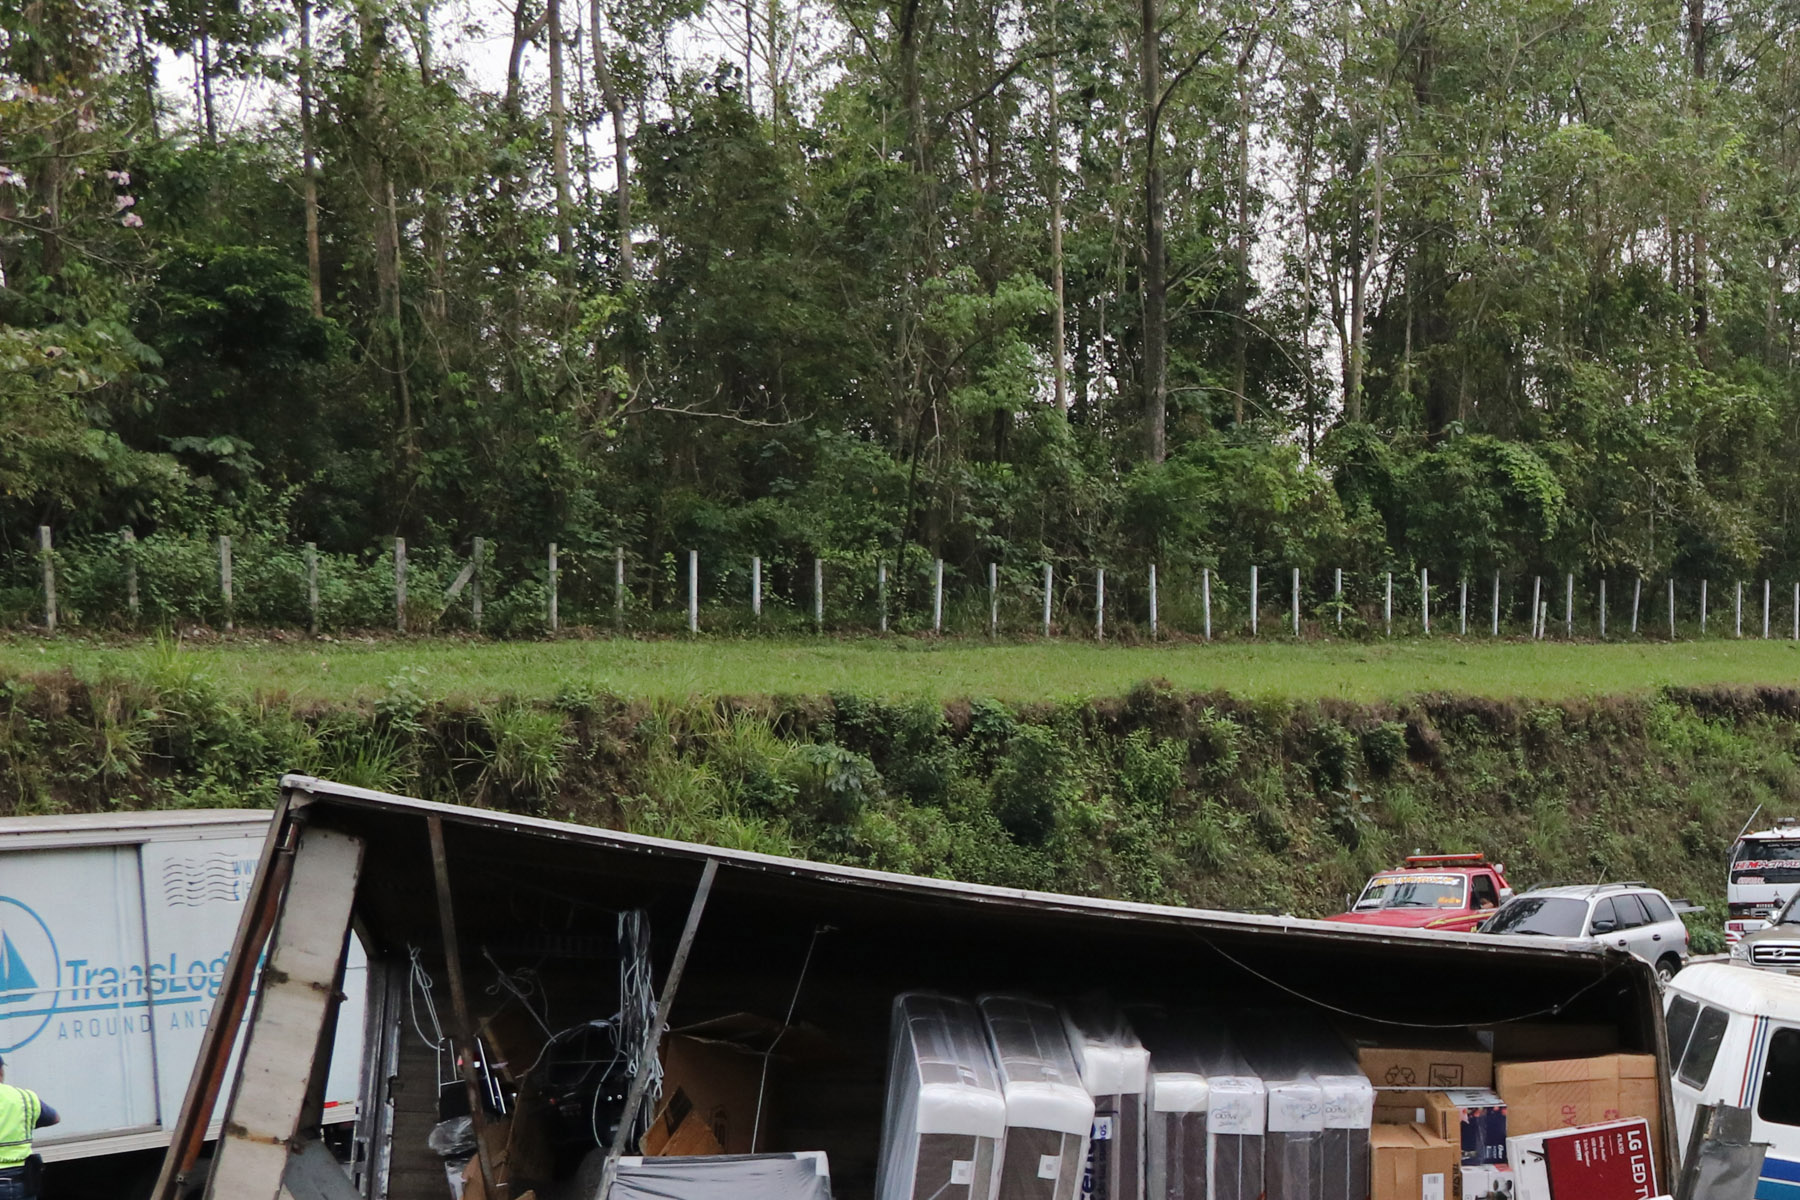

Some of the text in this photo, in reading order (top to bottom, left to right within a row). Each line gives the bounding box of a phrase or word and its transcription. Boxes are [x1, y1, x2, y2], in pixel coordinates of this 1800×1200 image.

[57, 1008, 209, 1040] AROUND AND
[1627, 1130, 1642, 1151] LG
[1630, 1154, 1647, 1184] LED
